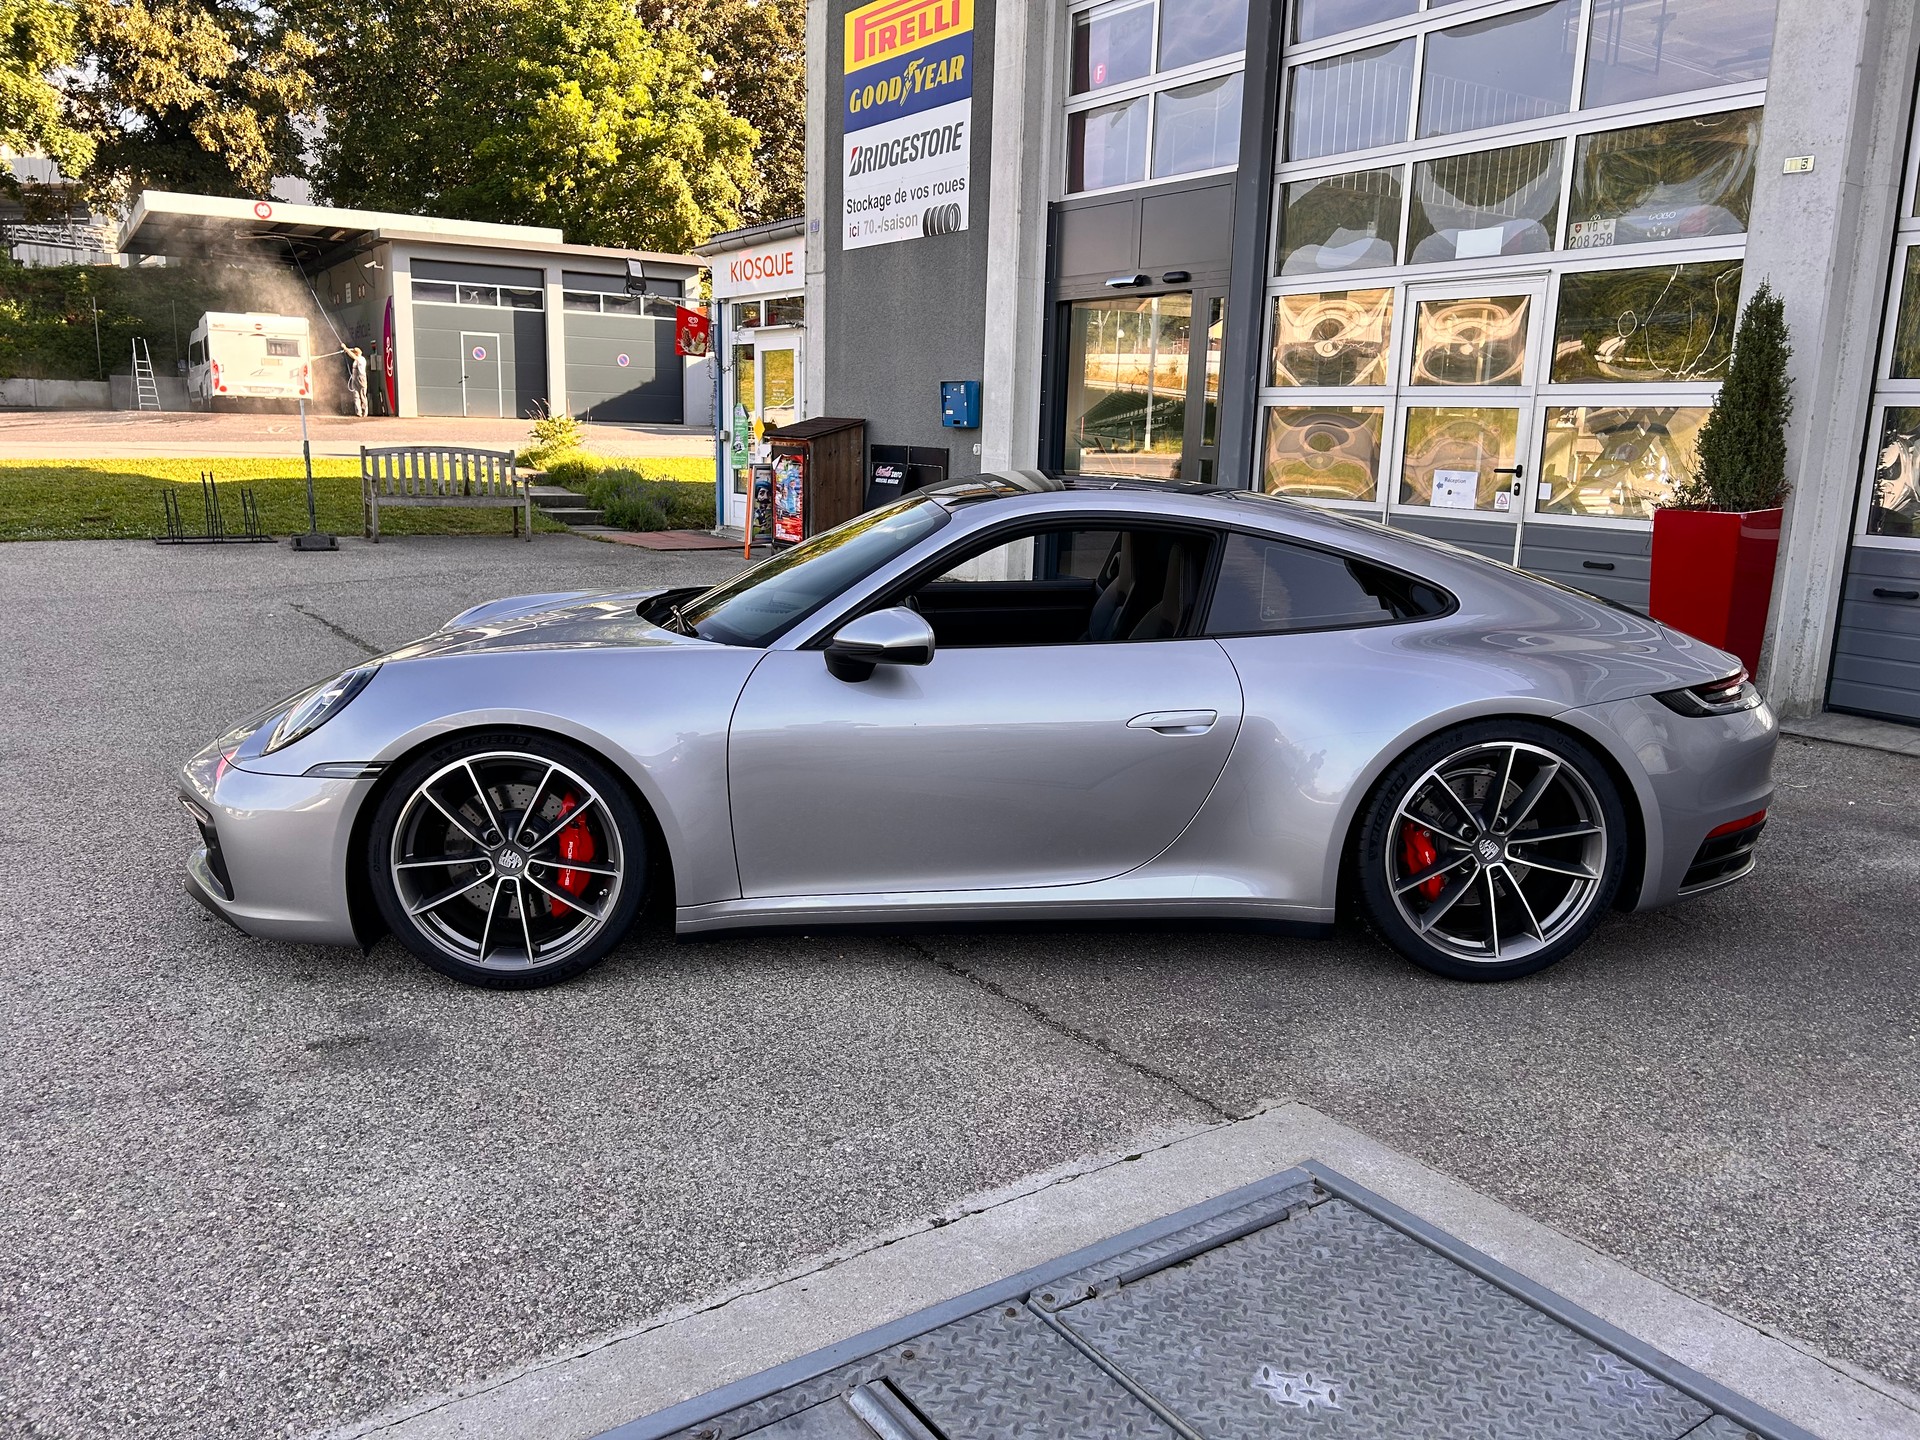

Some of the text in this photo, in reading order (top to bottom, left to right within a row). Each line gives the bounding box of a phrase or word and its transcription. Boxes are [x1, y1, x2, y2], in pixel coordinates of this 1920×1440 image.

[854, 0, 960, 62] PIRELLI
[849, 121, 965, 178] BRIDGESTONE
[846, 177, 966, 215] Stockage de vos roues
[849, 221, 860, 238] ici
[1570, 232, 1613, 250] 208 258
[730, 251, 794, 283] KIOSQUE
